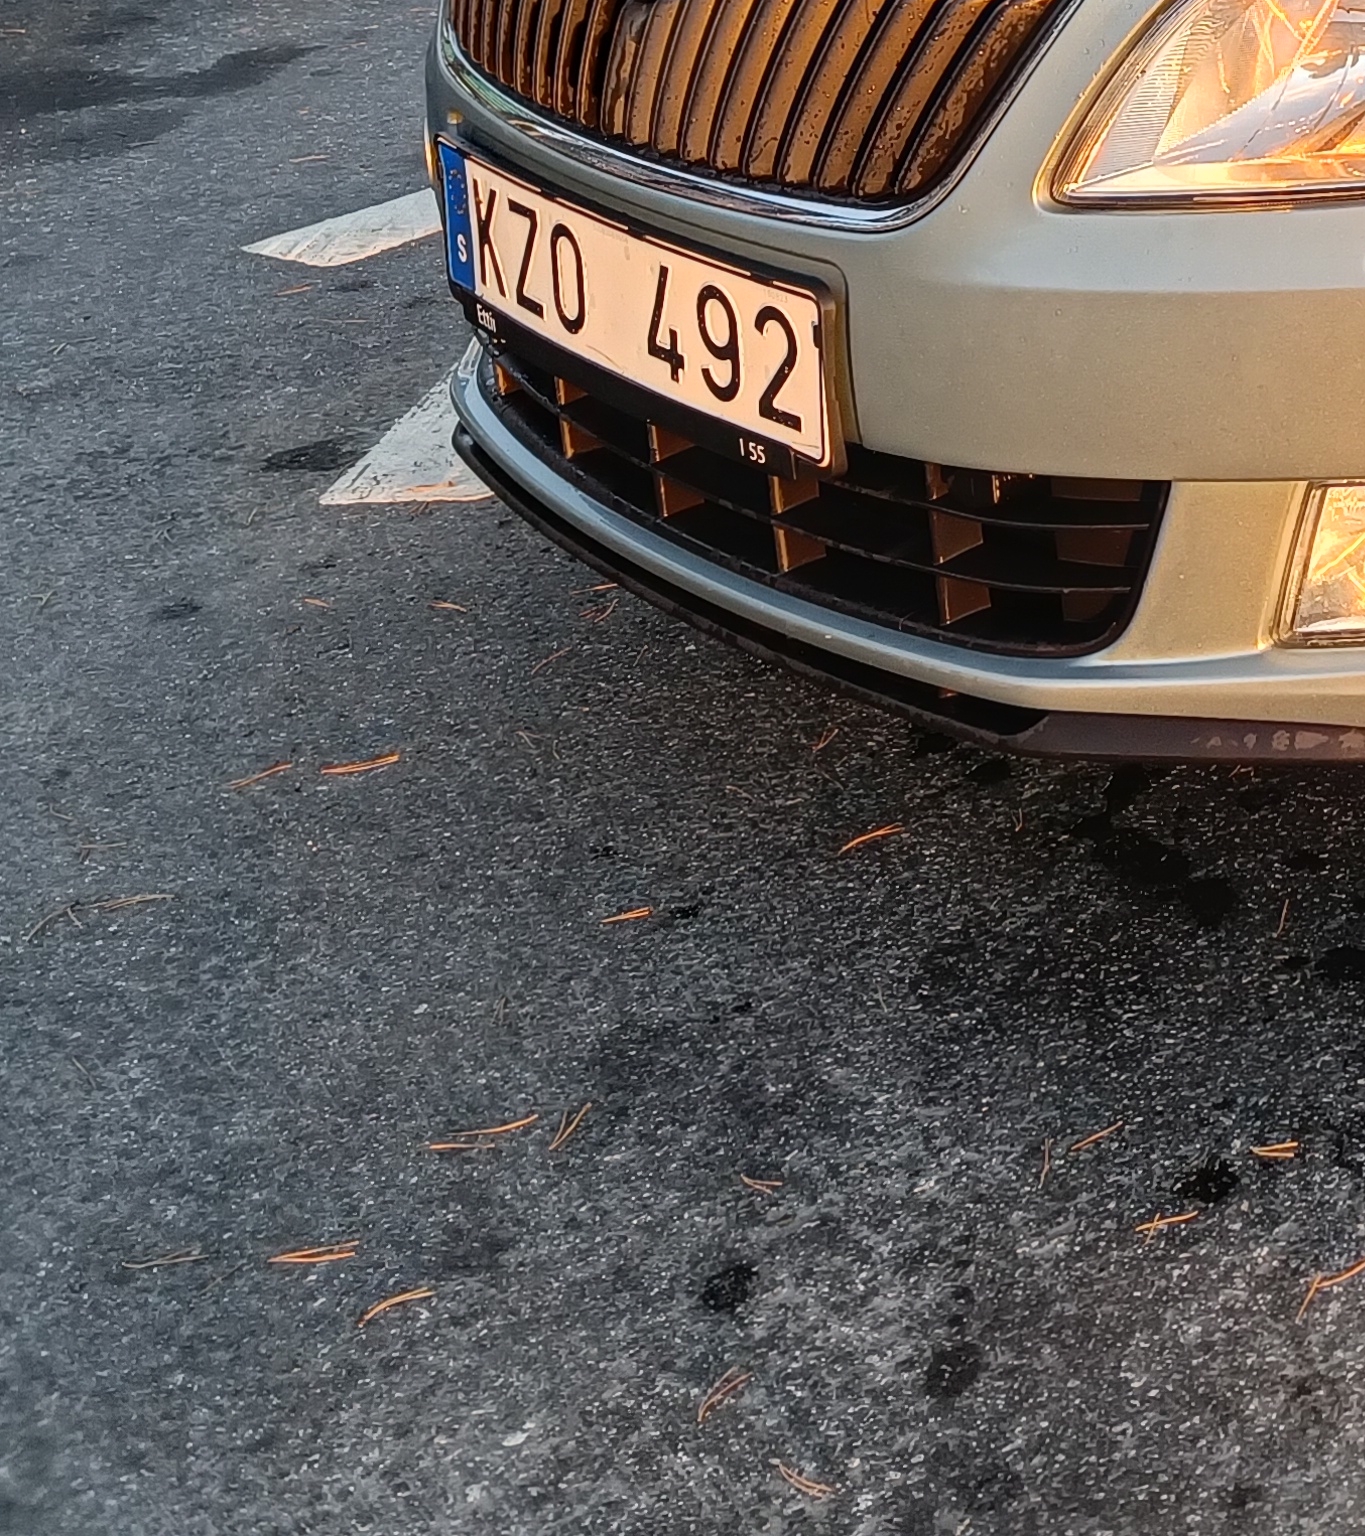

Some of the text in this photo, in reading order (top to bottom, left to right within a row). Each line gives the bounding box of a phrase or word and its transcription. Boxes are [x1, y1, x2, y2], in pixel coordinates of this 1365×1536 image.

[457, 233, 467, 263] S
[473, 177, 803, 434] KZO 492
